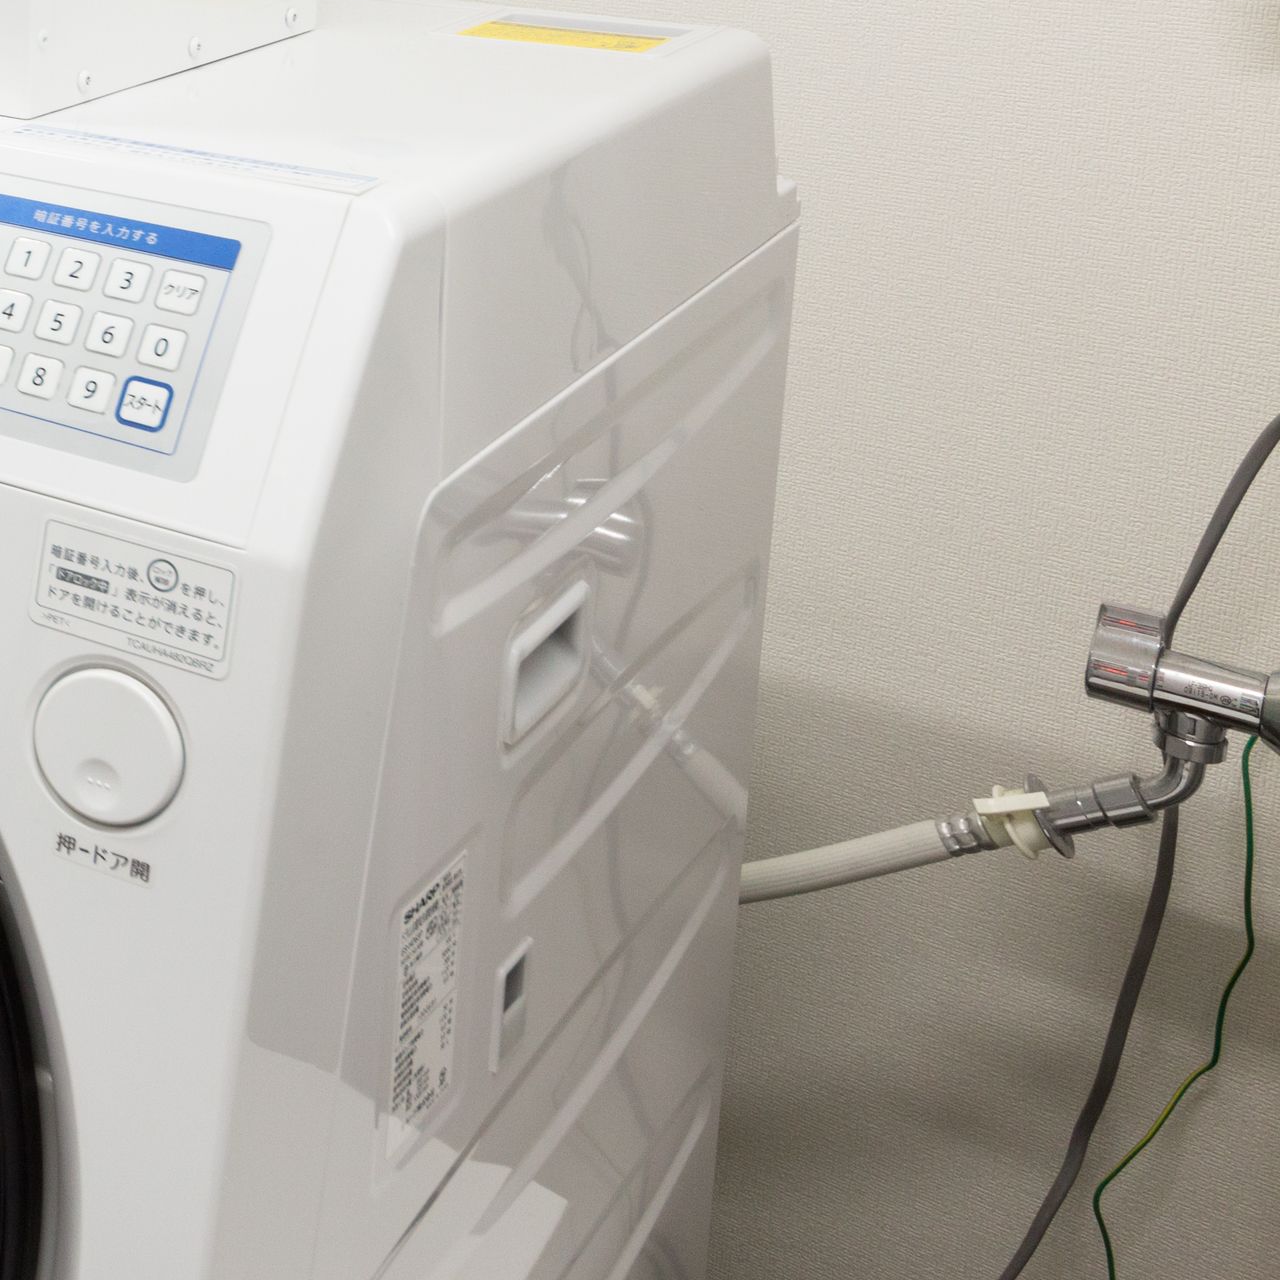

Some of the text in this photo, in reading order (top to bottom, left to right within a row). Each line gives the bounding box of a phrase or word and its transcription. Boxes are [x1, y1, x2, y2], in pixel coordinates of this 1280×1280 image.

[33, 208, 159, 246] 暗証番号を入力する
[24, 251, 134, 289] 1 2 3
[166, 284, 199, 298] クリア
[2, 303, 168, 357] 4 5 6 0
[32, 368, 46, 386] 8
[84, 381, 97, 398] 9
[124, 392, 163, 416] スタート
